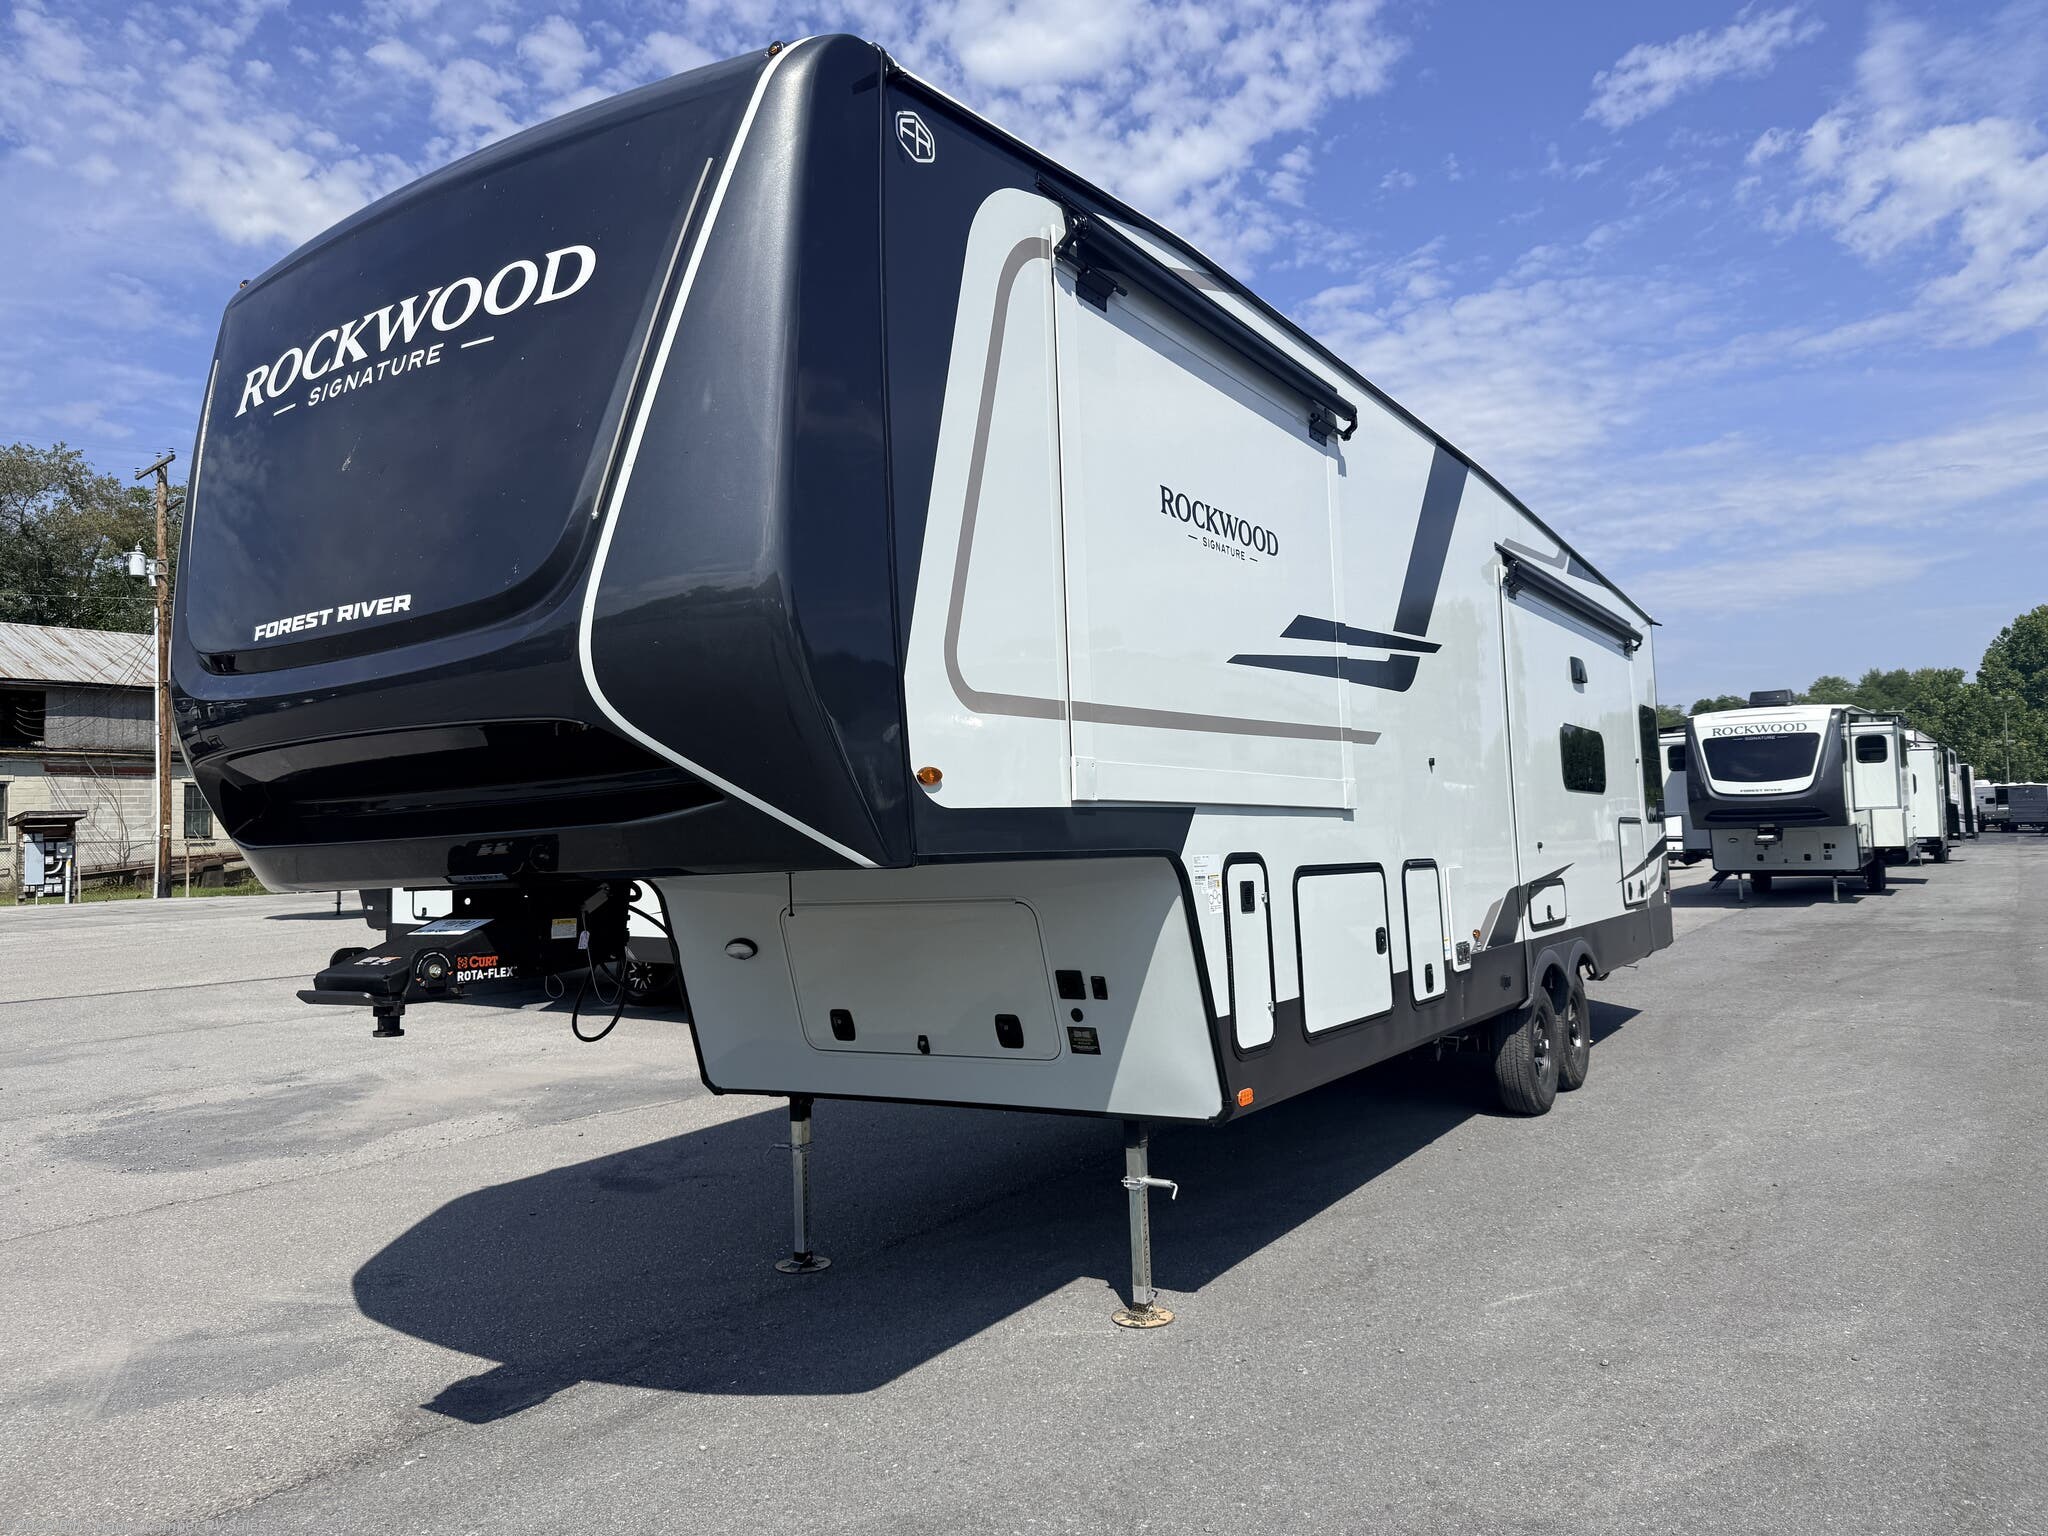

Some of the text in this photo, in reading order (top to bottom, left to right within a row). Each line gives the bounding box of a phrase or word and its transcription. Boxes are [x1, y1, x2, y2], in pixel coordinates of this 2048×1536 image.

[234, 244, 597, 418] ROCKWOOD
[308, 342, 445, 407] SIGNATURE
[1159, 484, 1279, 557] ROCKWOOD
[1202, 536, 1246, 561] SIGNATURE
[254, 594, 412, 641] FOREST RIVER
[1712, 722, 1808, 737] ROCKWOOD
[469, 955, 498, 968] CURT
